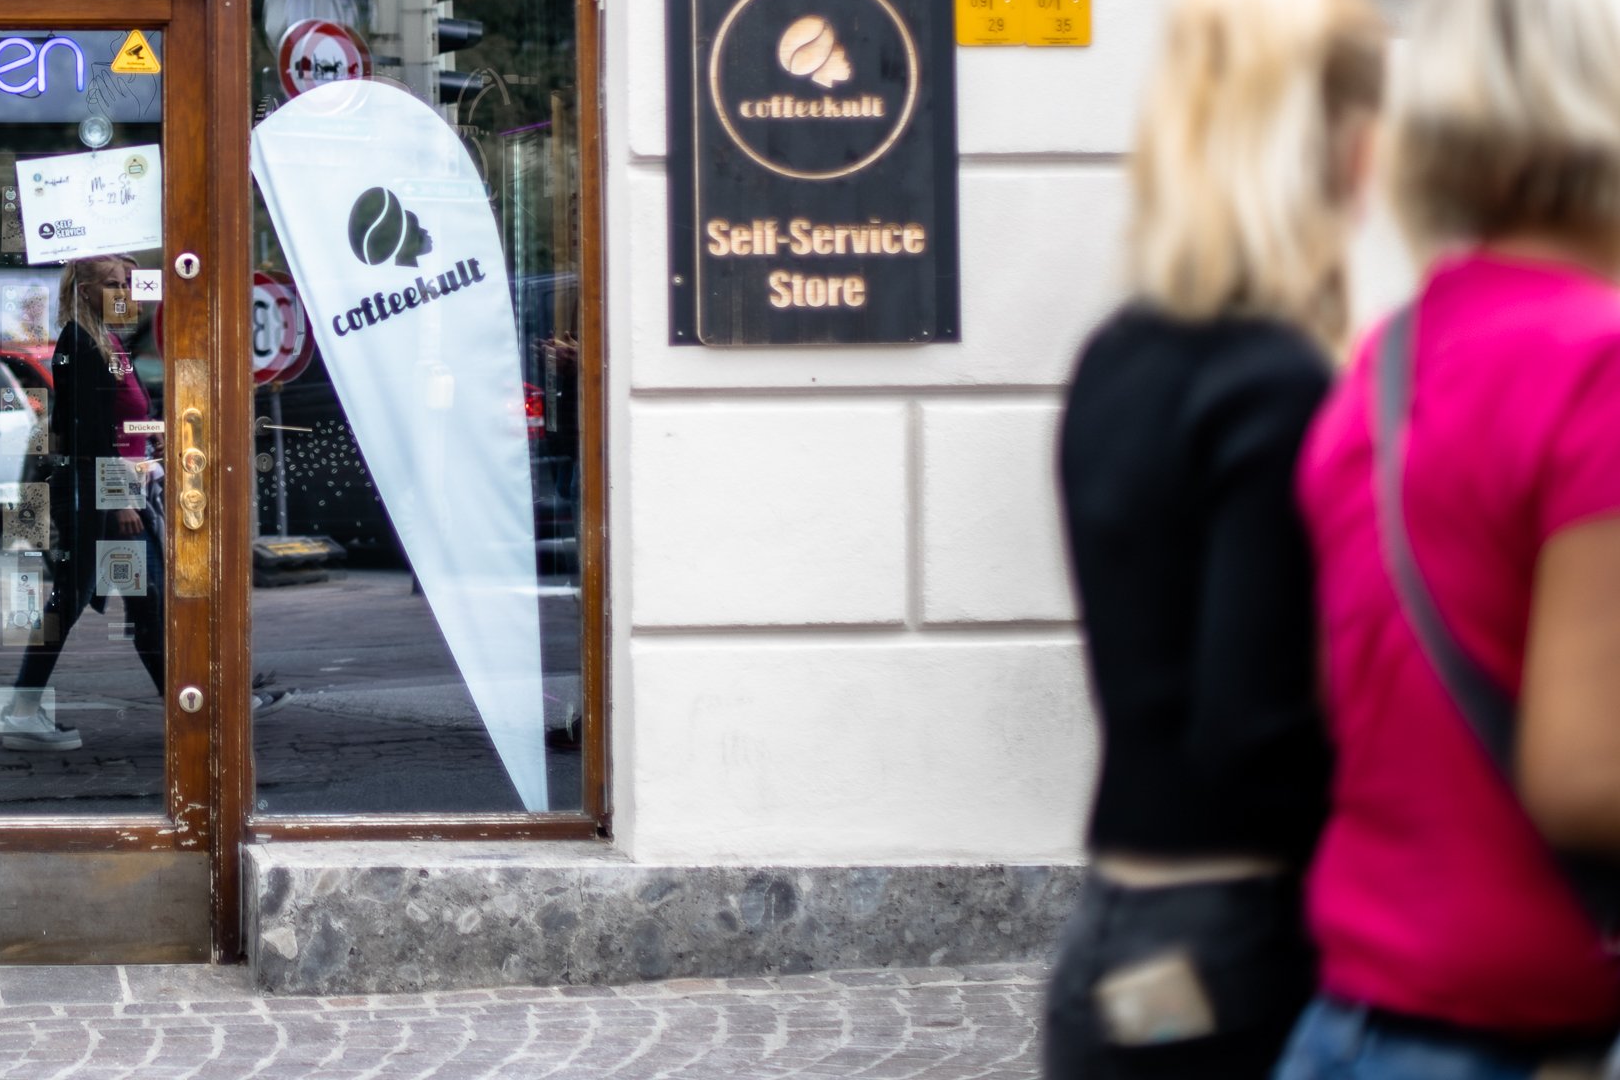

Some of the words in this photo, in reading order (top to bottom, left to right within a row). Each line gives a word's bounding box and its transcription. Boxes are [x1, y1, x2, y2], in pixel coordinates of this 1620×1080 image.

[739, 95, 885, 118] coffeekult
[54, 220, 72, 229] SELF
[56, 227, 86, 238] SERVICE
[707, 219, 925, 256] Self-Service
[332, 257, 486, 337] coffeekult
[768, 270, 866, 308] Store
[128, 423, 160, 432] Drücken
